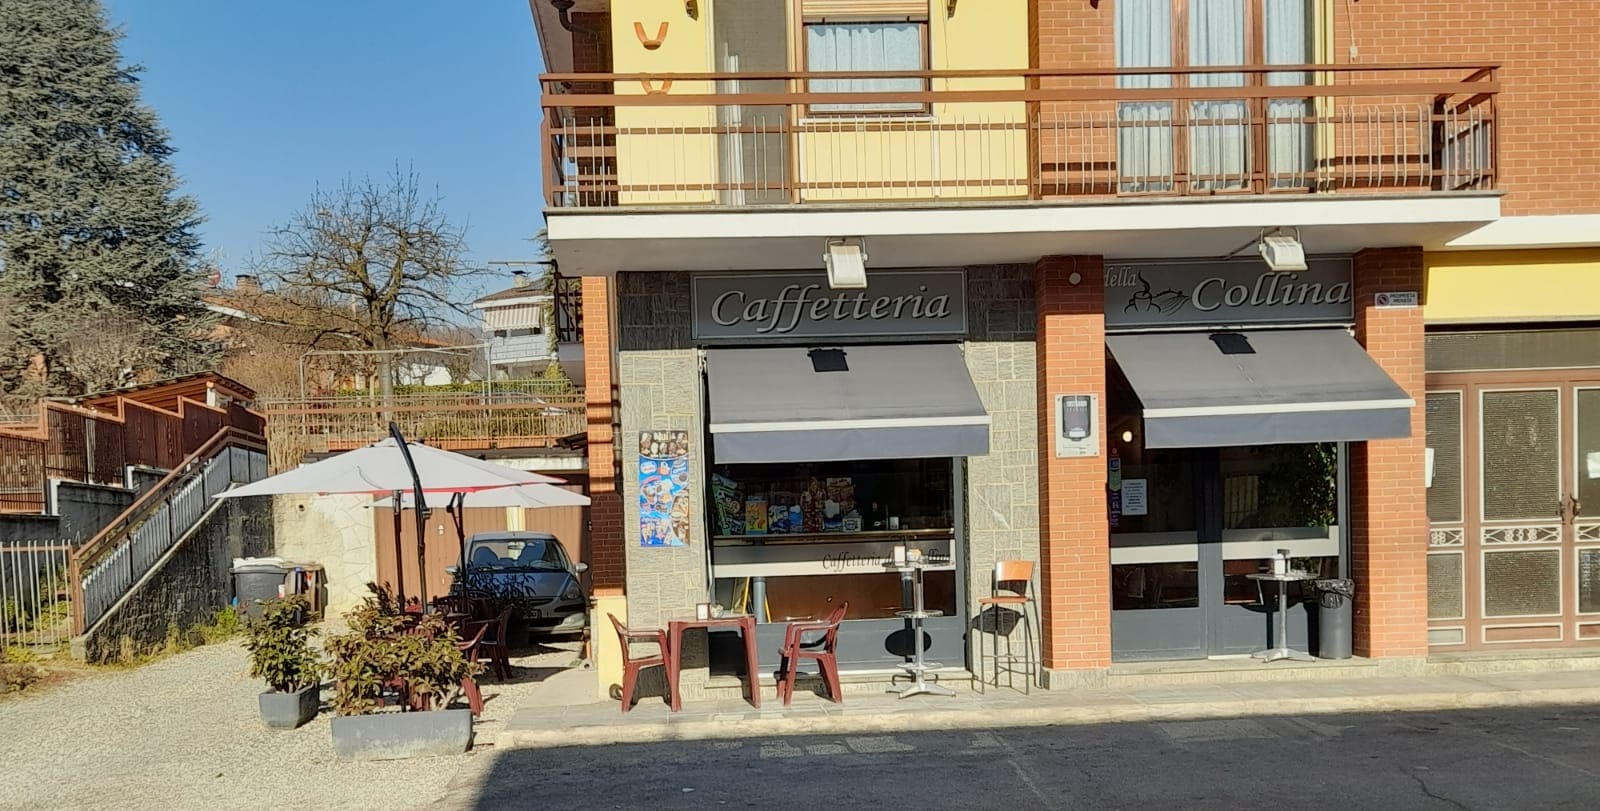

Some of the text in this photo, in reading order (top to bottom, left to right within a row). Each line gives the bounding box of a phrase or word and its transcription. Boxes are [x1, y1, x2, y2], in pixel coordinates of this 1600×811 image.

[711, 284, 951, 333] Caffetteria
[1191, 272, 1351, 311] Collina
[822, 551, 880, 572] Caffetteria
